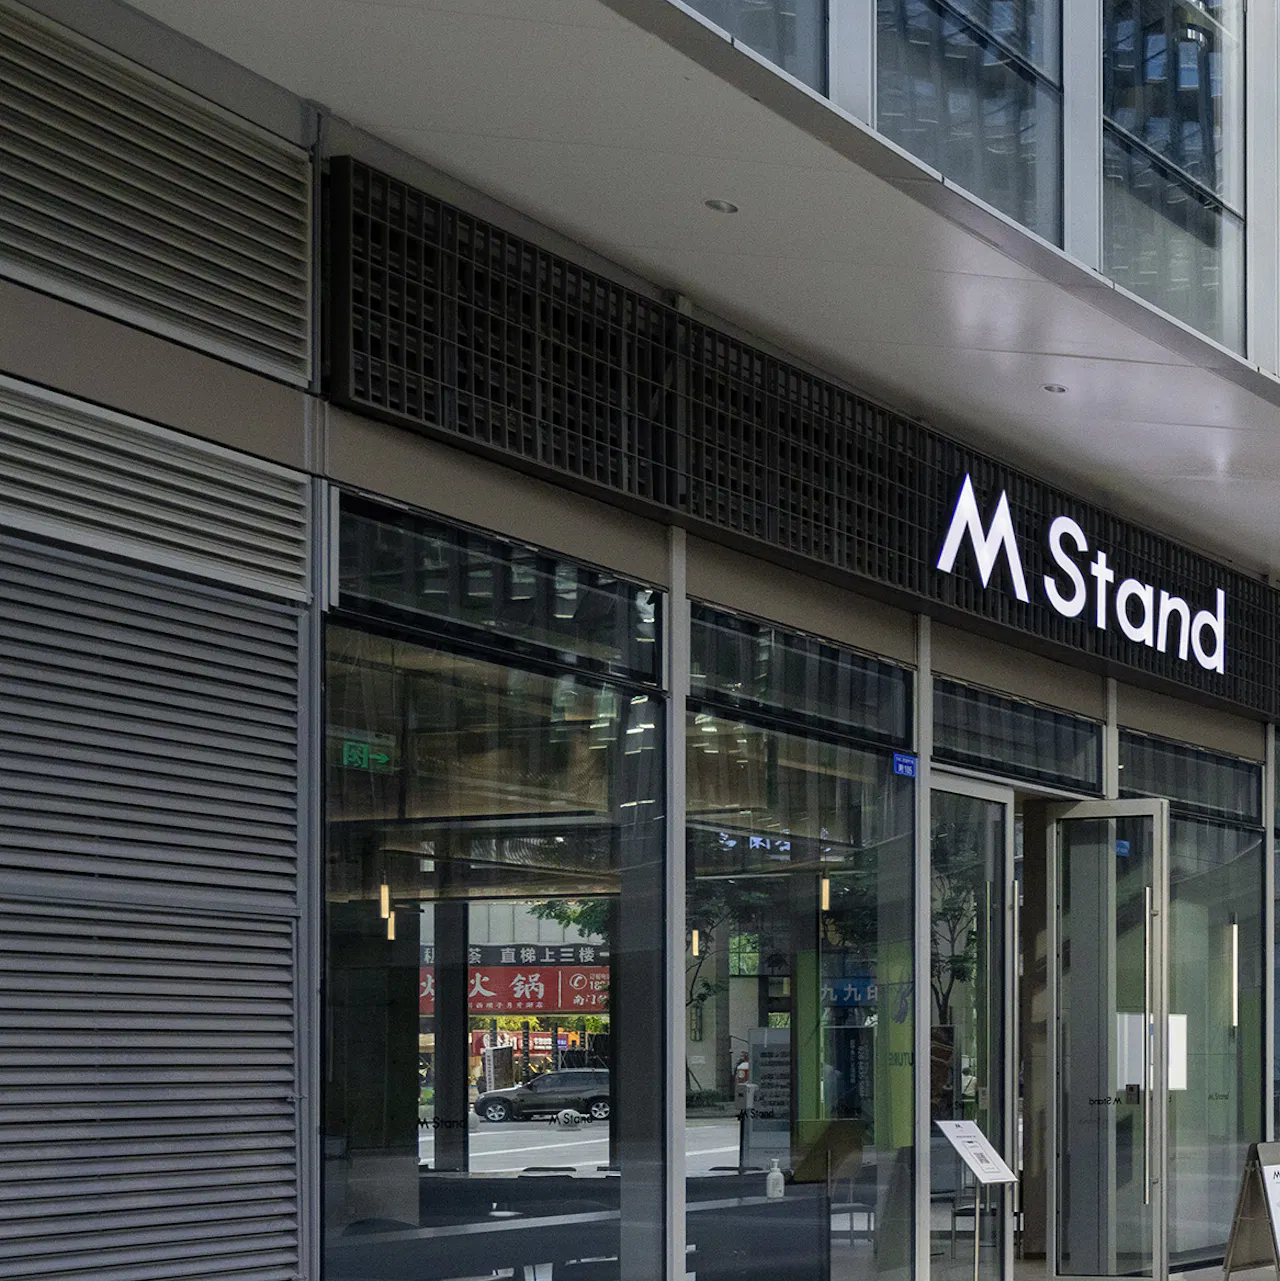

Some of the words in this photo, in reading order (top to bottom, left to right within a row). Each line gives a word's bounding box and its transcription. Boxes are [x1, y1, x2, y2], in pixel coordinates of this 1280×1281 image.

[936, 472, 1030, 604] M
[1043, 515, 1226, 675] Stand
[563, 1112, 593, 1125] Stand
